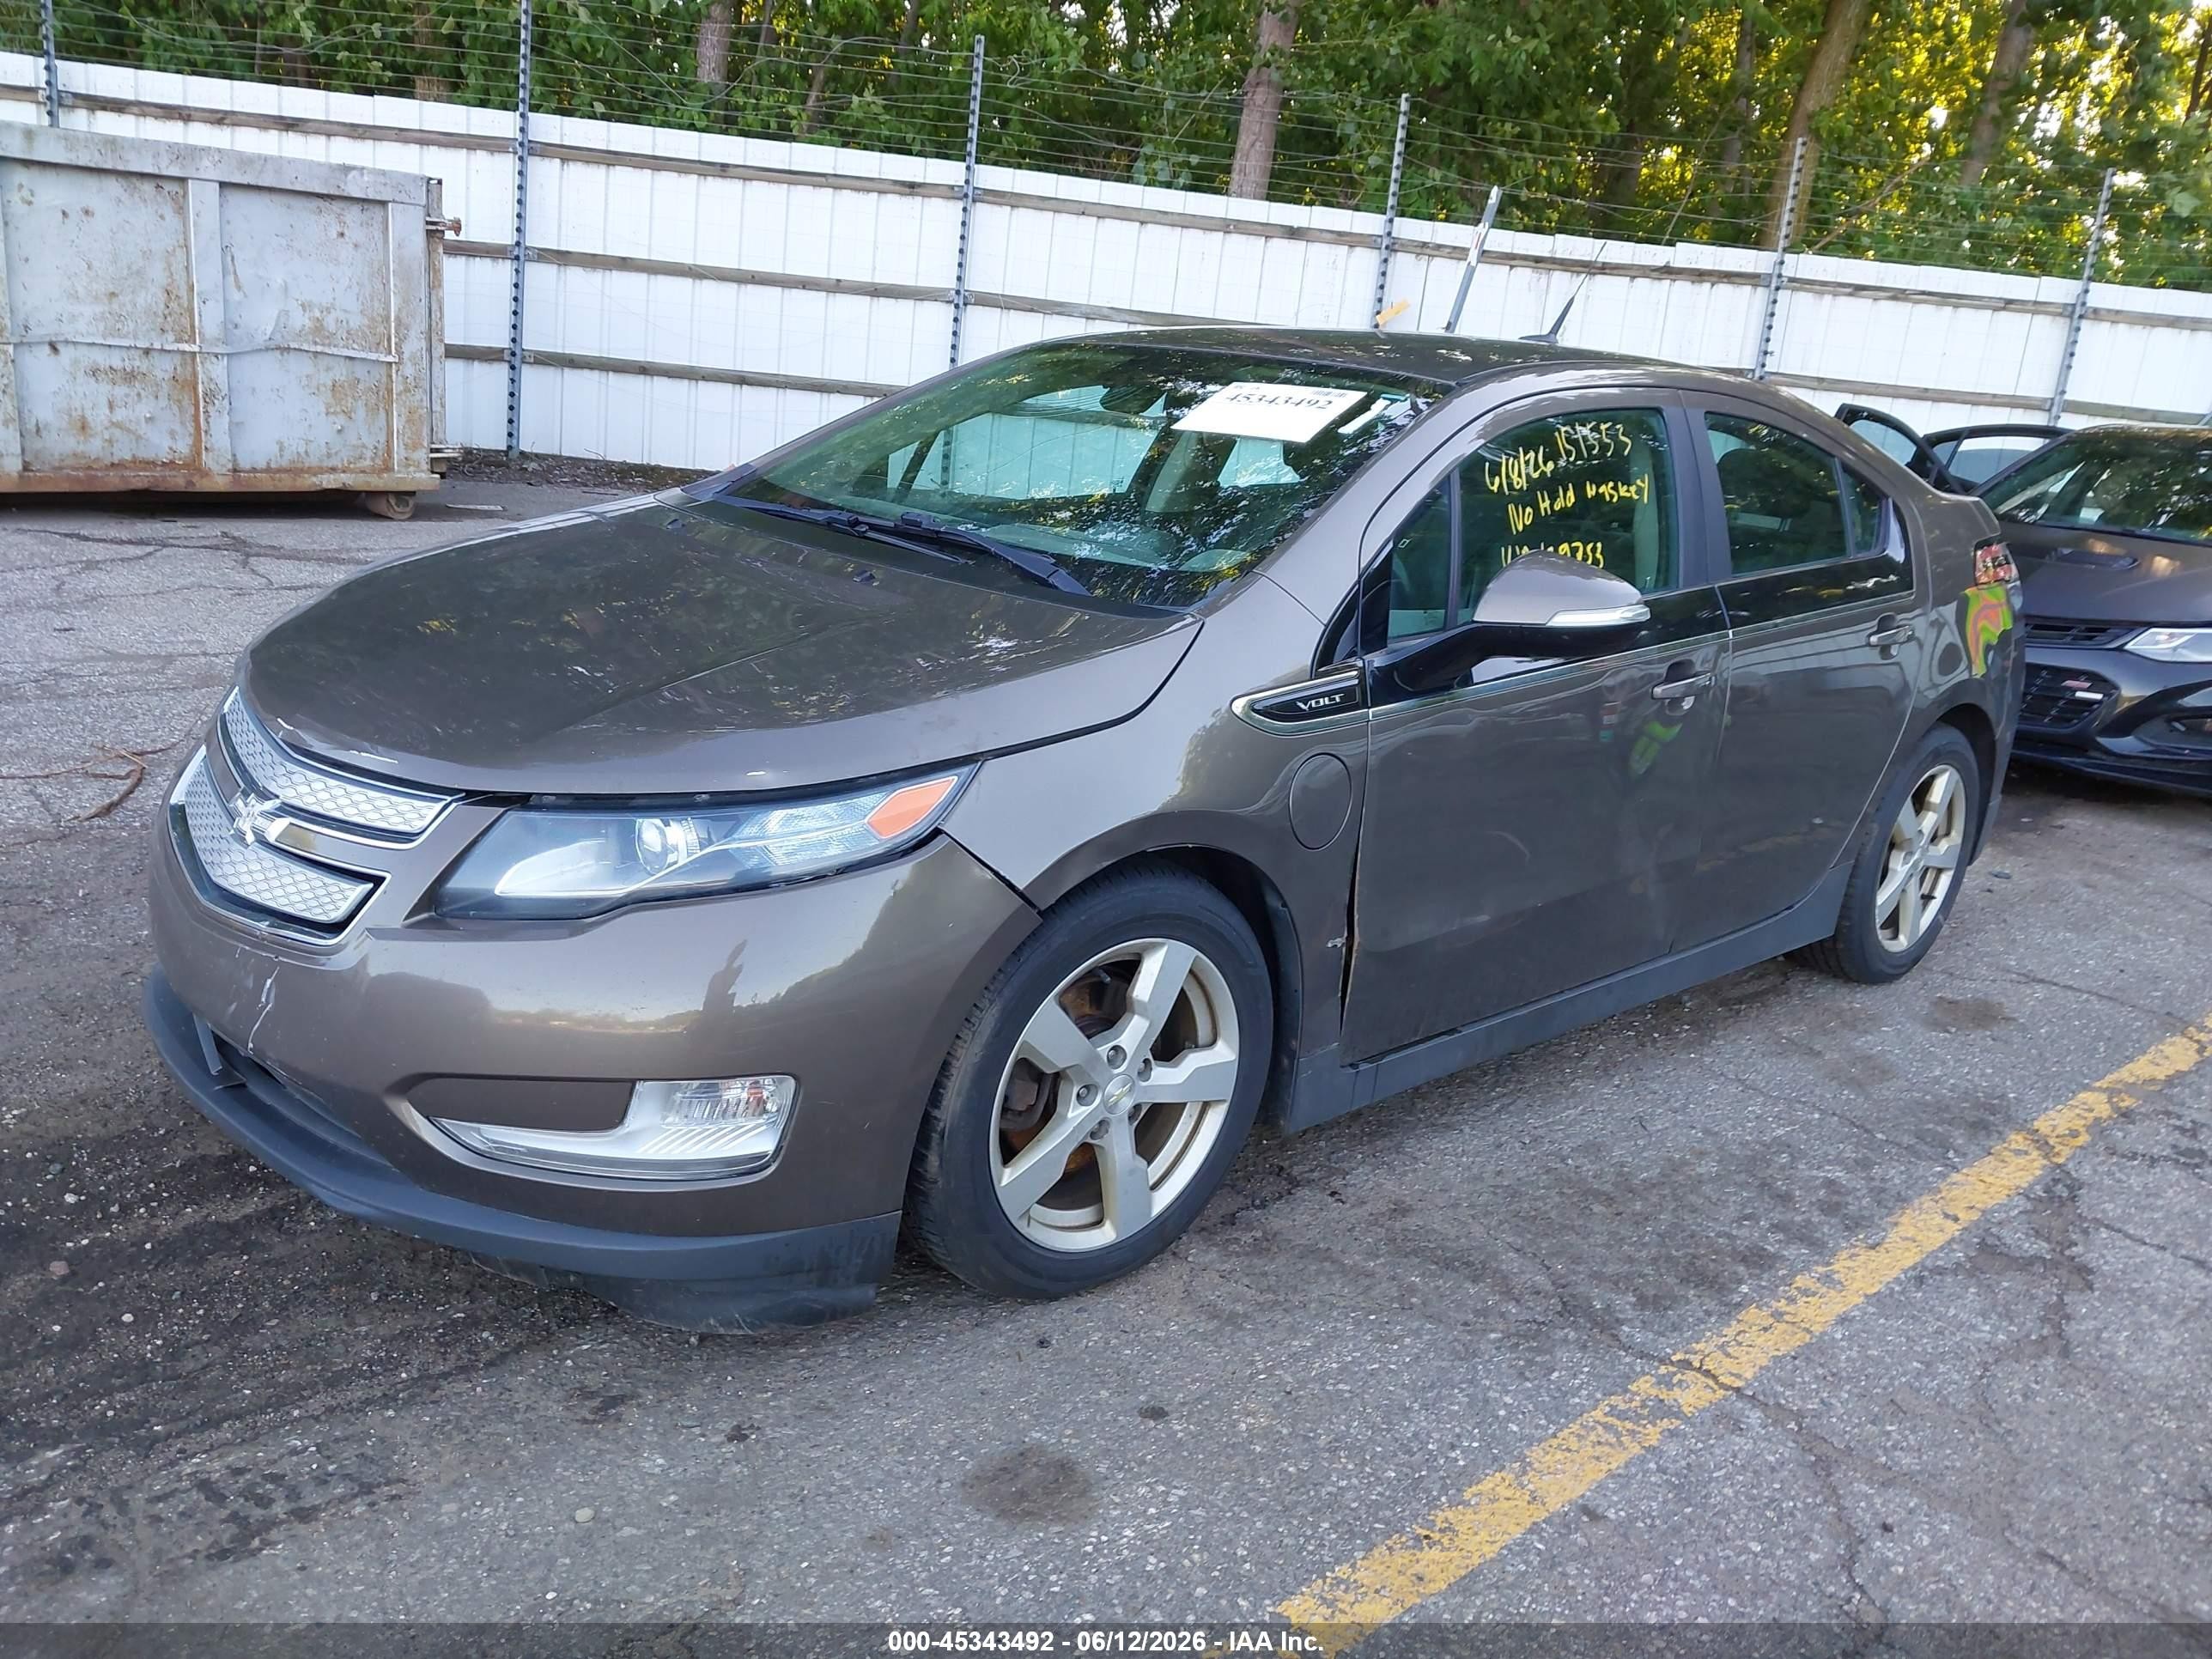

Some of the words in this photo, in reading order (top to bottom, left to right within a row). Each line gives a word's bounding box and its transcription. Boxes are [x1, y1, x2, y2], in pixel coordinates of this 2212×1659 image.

[1227, 393, 1333, 409] 45343492
[1508, 502, 1534, 536] No
[1296, 693, 1346, 711] VOLT
